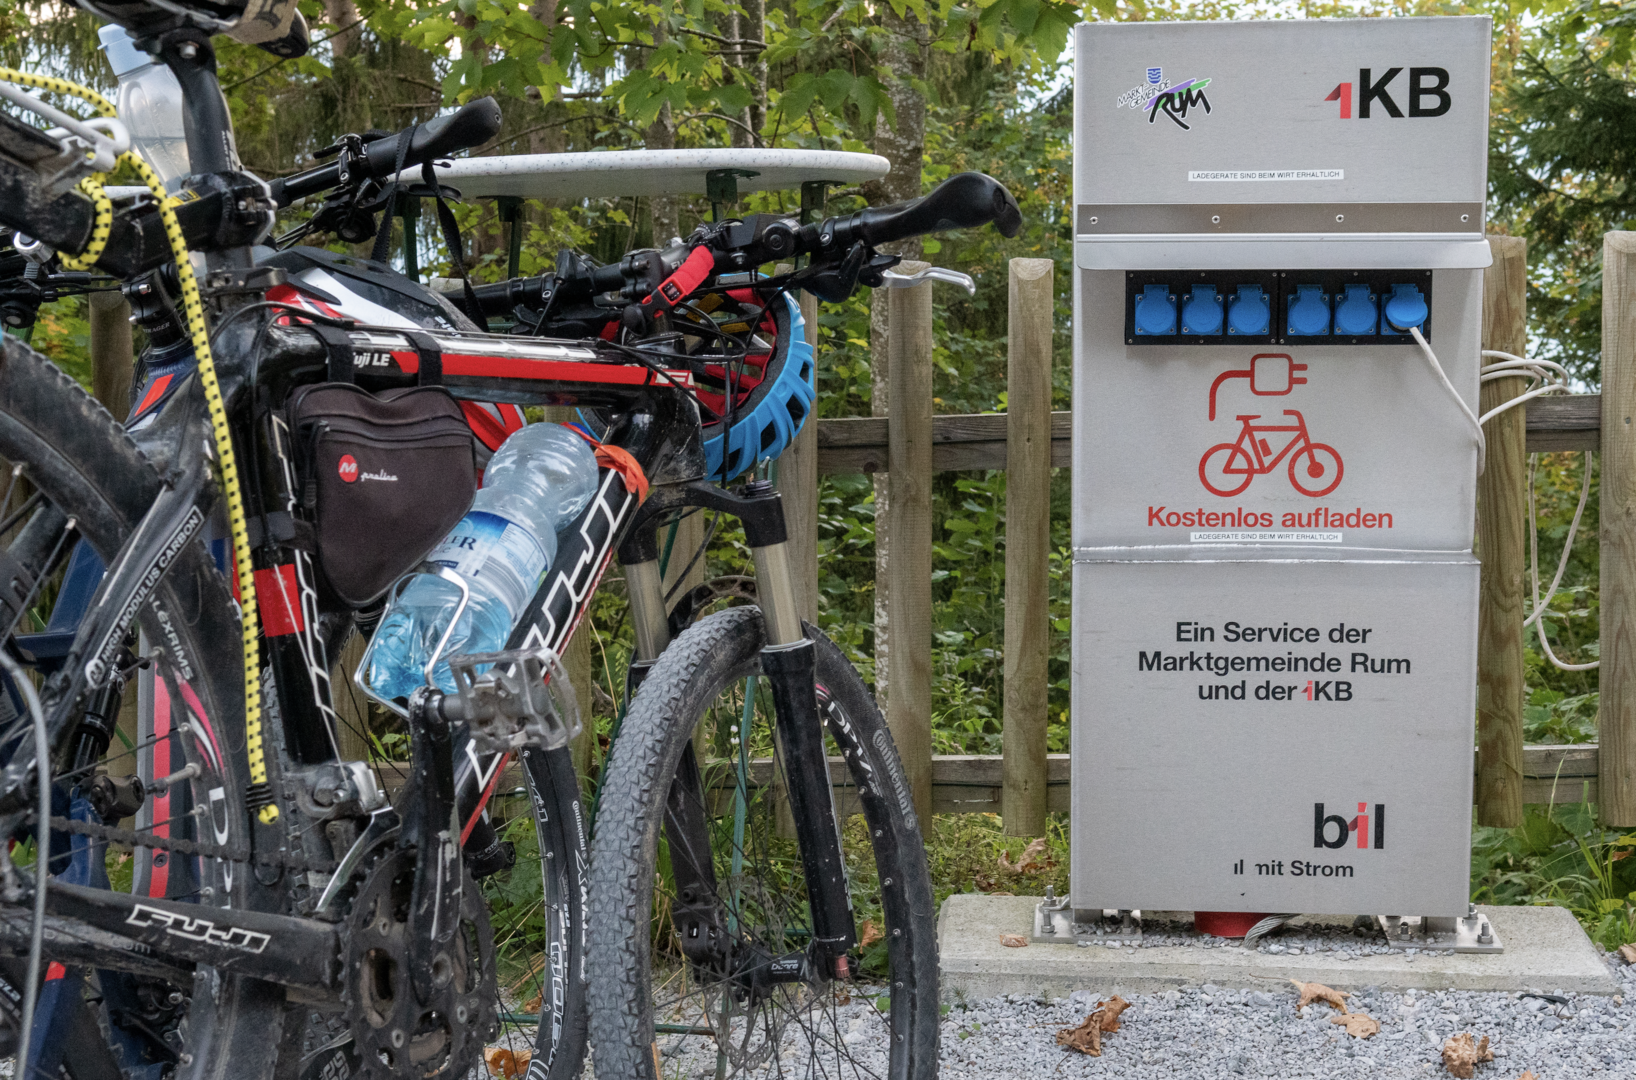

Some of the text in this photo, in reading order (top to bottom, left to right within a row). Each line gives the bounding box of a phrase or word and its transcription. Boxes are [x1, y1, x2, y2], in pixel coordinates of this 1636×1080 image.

[352, 352, 391, 368] uji LE
[1147, 506, 1393, 529] Kostenlos aufladen
[100, 513, 200, 662] HIGH MODULUS CARBON
[1176, 621, 1373, 644] Ein Service der
[1138, 650, 1411, 677] Marktgemeinde Rum
[1198, 679, 1246, 701] und
[1254, 680, 1298, 701] der
[873, 728, 913, 816] Continental
[571, 799, 587, 851] Continental
[1290, 859, 1354, 878] Strom
